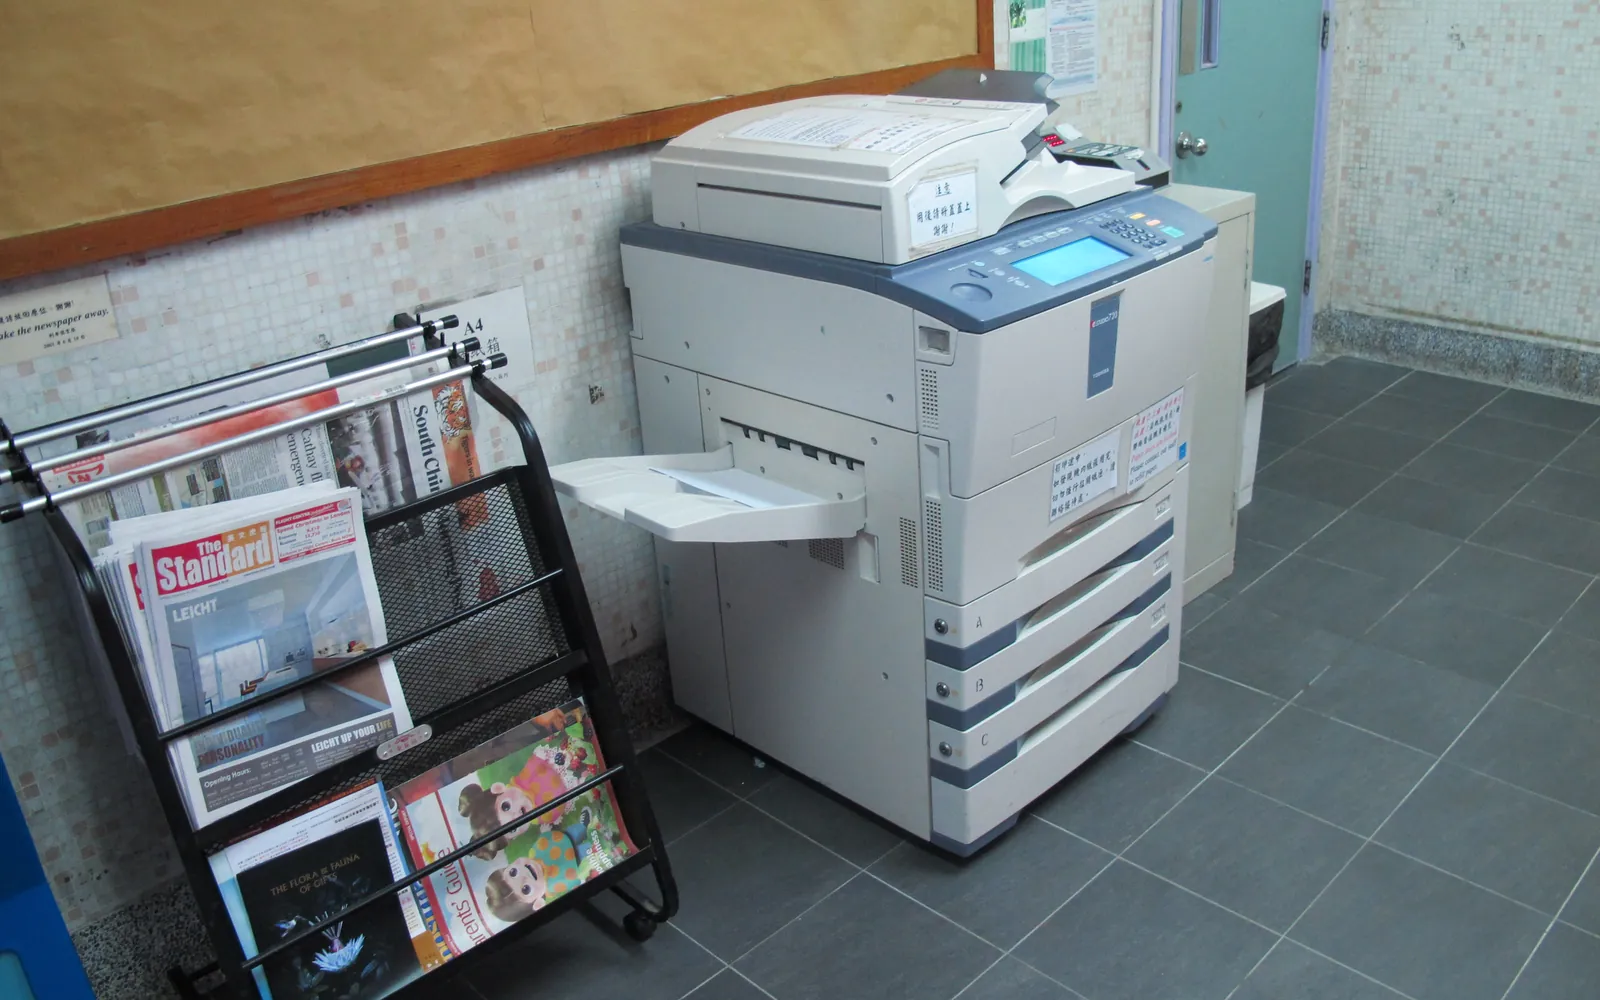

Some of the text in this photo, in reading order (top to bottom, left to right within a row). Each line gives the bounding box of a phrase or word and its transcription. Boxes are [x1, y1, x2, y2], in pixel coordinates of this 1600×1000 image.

[935, 182, 952, 195] 注意
[17, 325, 32, 337] the
[34, 314, 82, 333] newspaper
[84, 308, 109, 319] away.
[464, 318, 484, 336] A4
[413, 403, 434, 457] South
[287, 432, 305, 487] emergen
[301, 427, 318, 469] Cathay
[196, 540, 222, 556] The
[157, 532, 272, 591] Standard
[172, 597, 218, 623] LEICHT
[976, 616, 983, 629] A
[975, 678, 984, 692] B
[311, 719, 393, 753] LEICHT UP YOUR LIFE
[981, 733, 989, 746] C
[204, 768, 252, 788] Opening Hours:
[270, 882, 289, 896] THE
[290, 871, 320, 889] FLORA
[330, 853, 361, 870] FAUNA
[300, 883, 312, 894] OF
